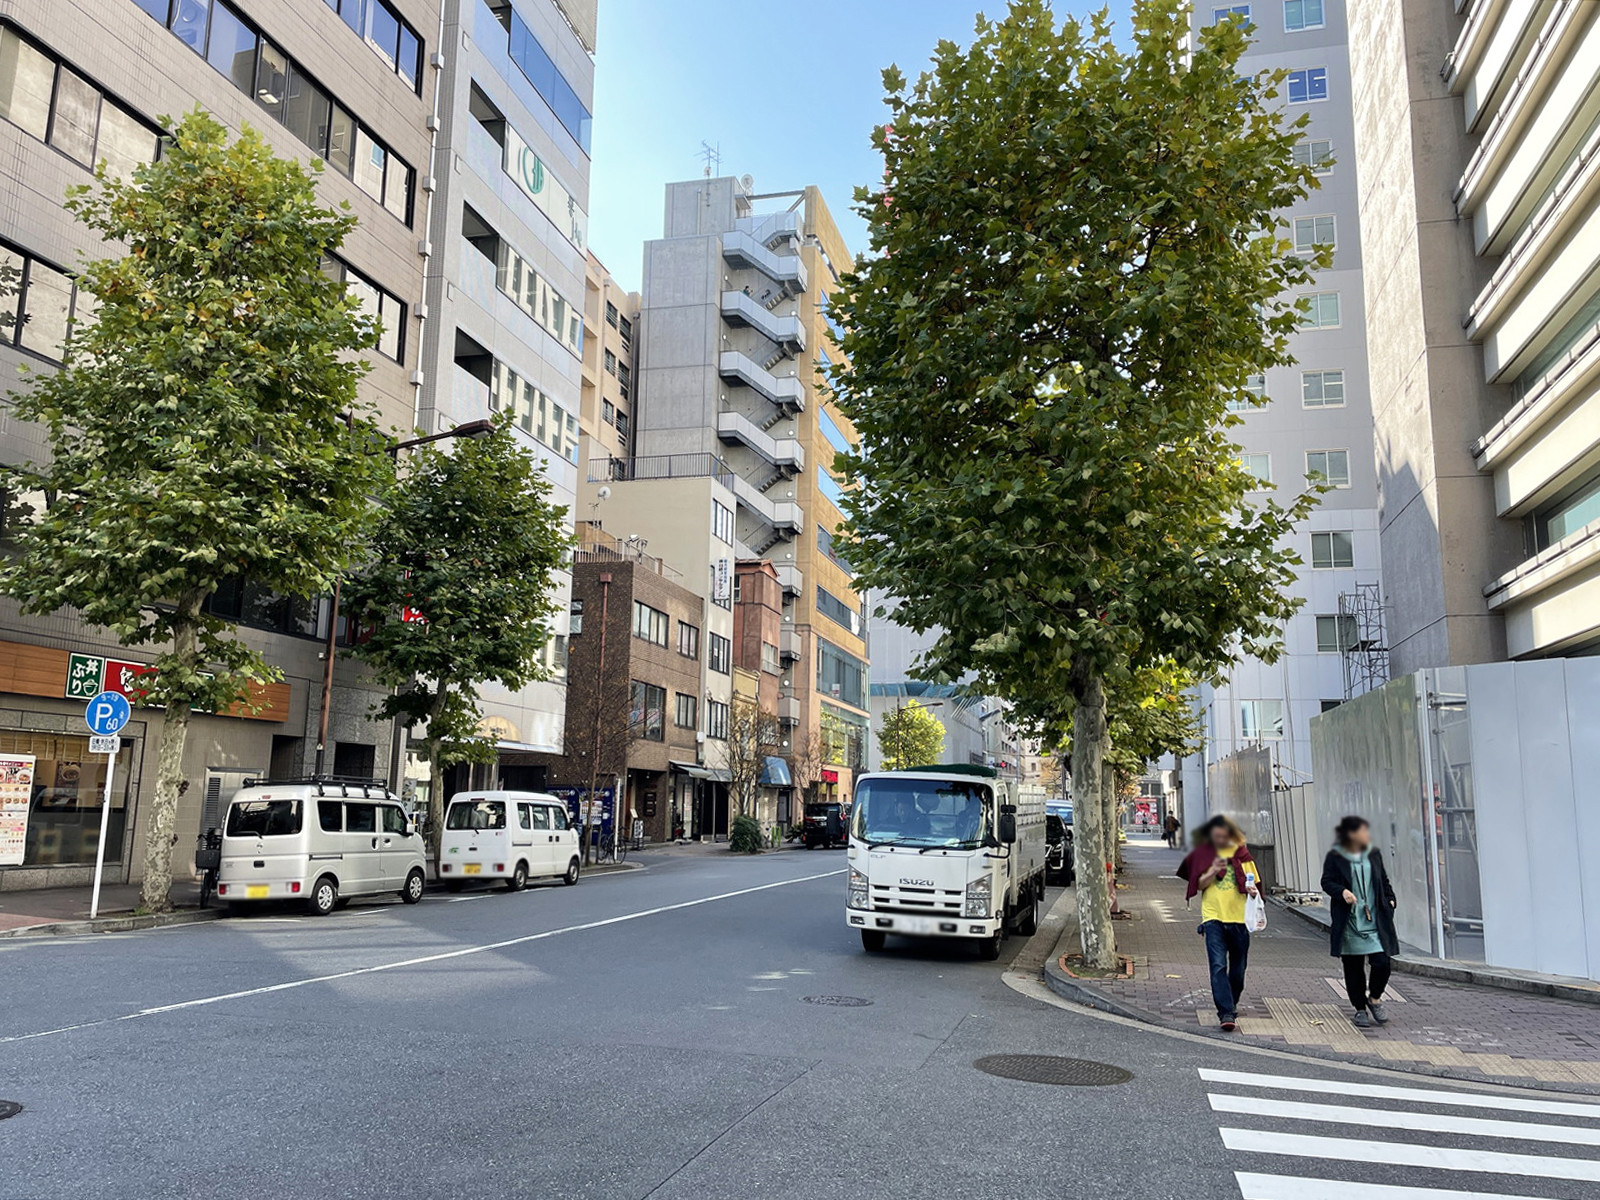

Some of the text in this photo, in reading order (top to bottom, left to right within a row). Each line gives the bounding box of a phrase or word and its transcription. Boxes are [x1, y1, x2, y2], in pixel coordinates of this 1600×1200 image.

[95, 703, 113, 730] P
[106, 718, 119, 730] 60
[899, 878, 934, 886] ISUZU
